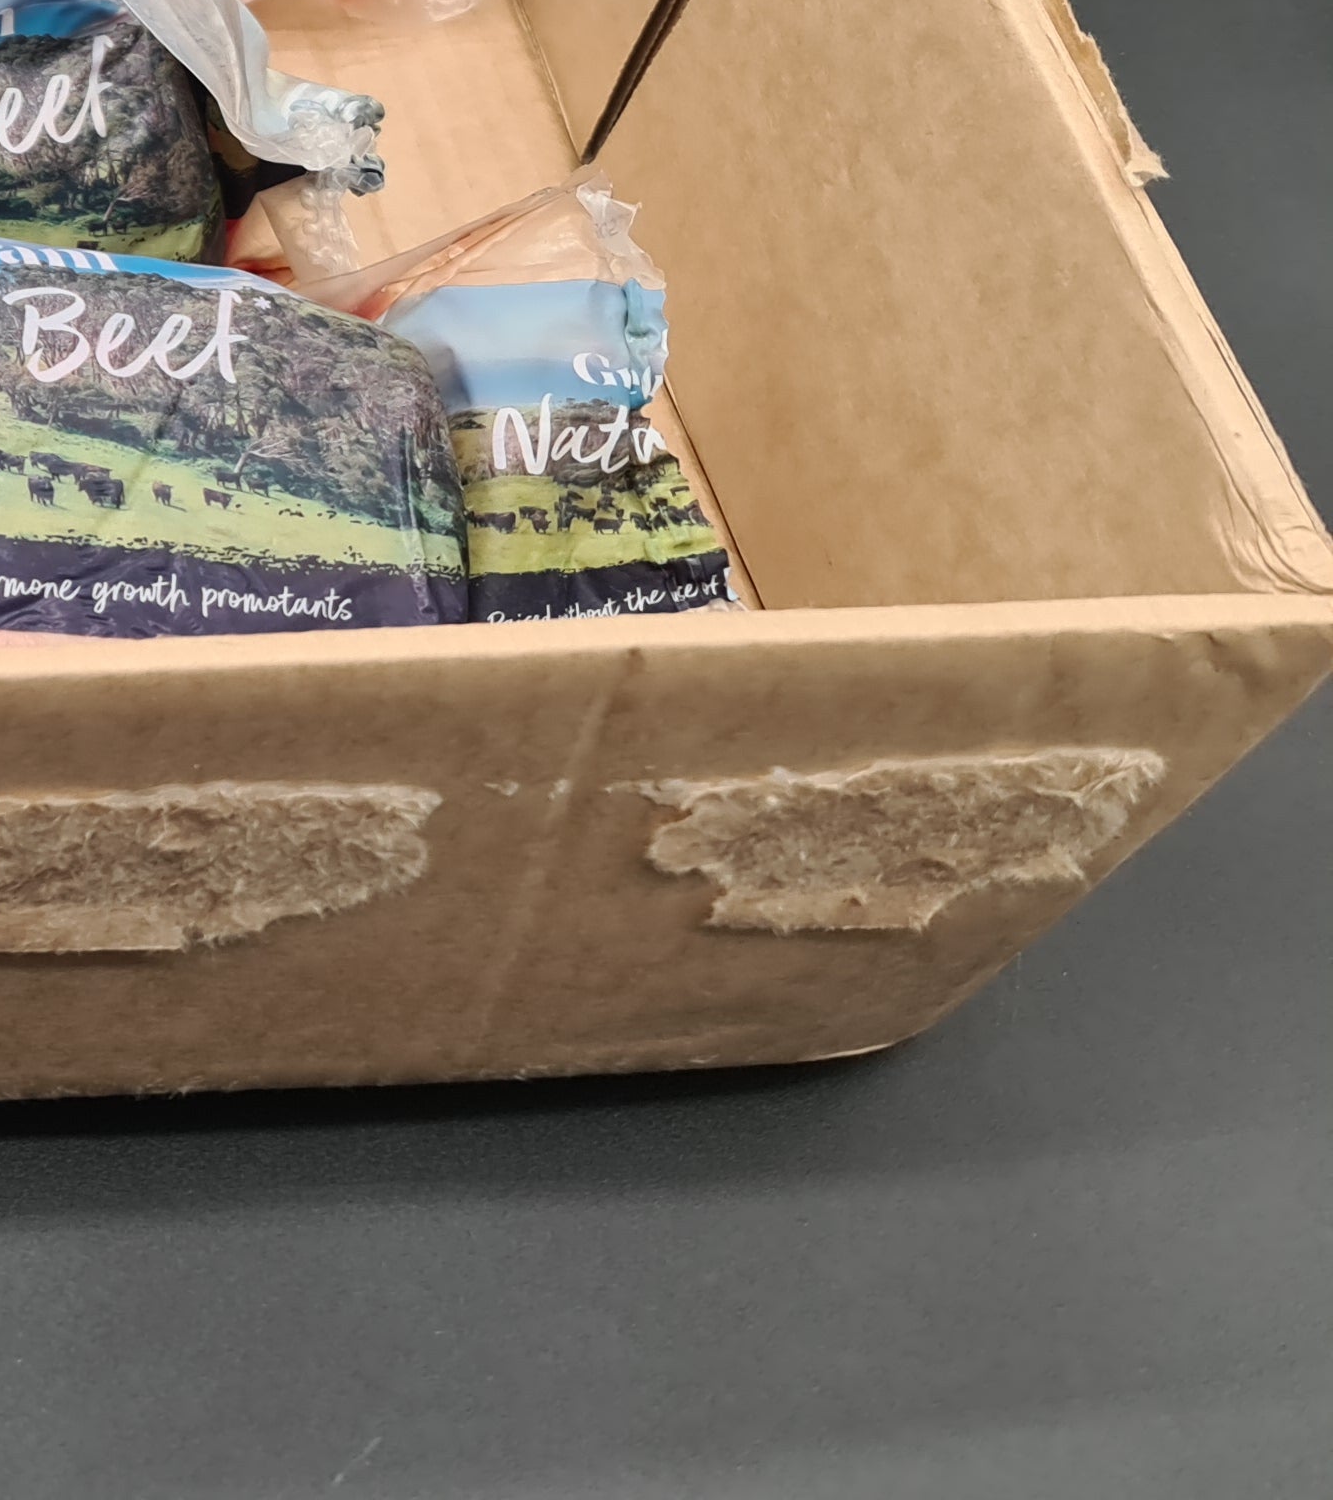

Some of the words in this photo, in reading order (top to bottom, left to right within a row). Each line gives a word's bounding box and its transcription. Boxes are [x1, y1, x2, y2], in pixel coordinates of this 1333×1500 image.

[2, 288, 250, 384] Beef
[92, 573, 190, 614] growth
[201, 586, 353, 622] promotants
[624, 586, 666, 612] the
